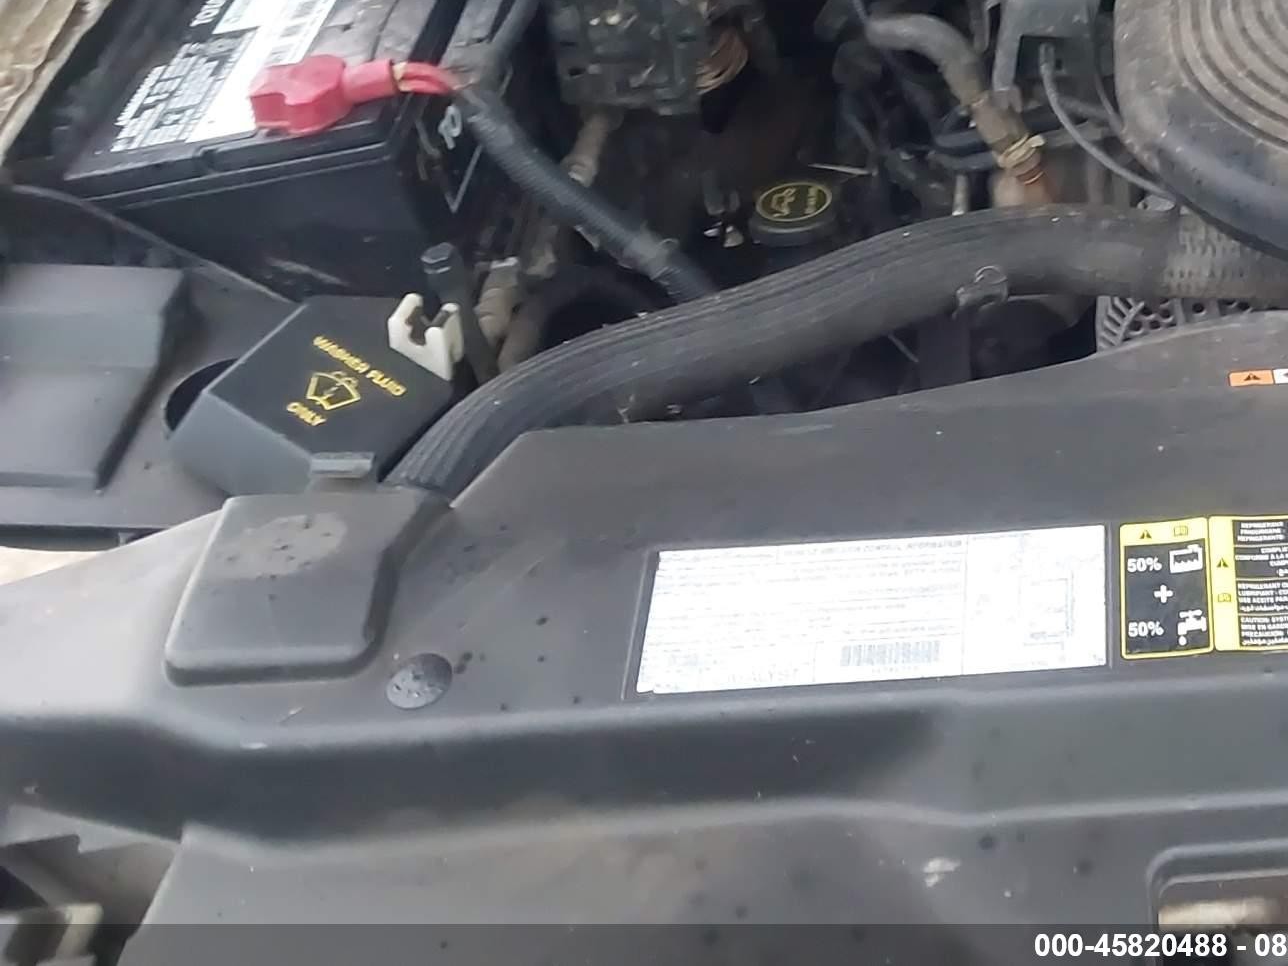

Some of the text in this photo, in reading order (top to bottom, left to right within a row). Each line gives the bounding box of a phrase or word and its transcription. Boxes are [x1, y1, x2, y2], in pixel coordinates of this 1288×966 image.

[313, 336, 407, 396] WASHER FLUID
[286, 402, 327, 426] ONLY
[1127, 557, 1162, 573] 50%
[1128, 621, 1164, 637] 50%
